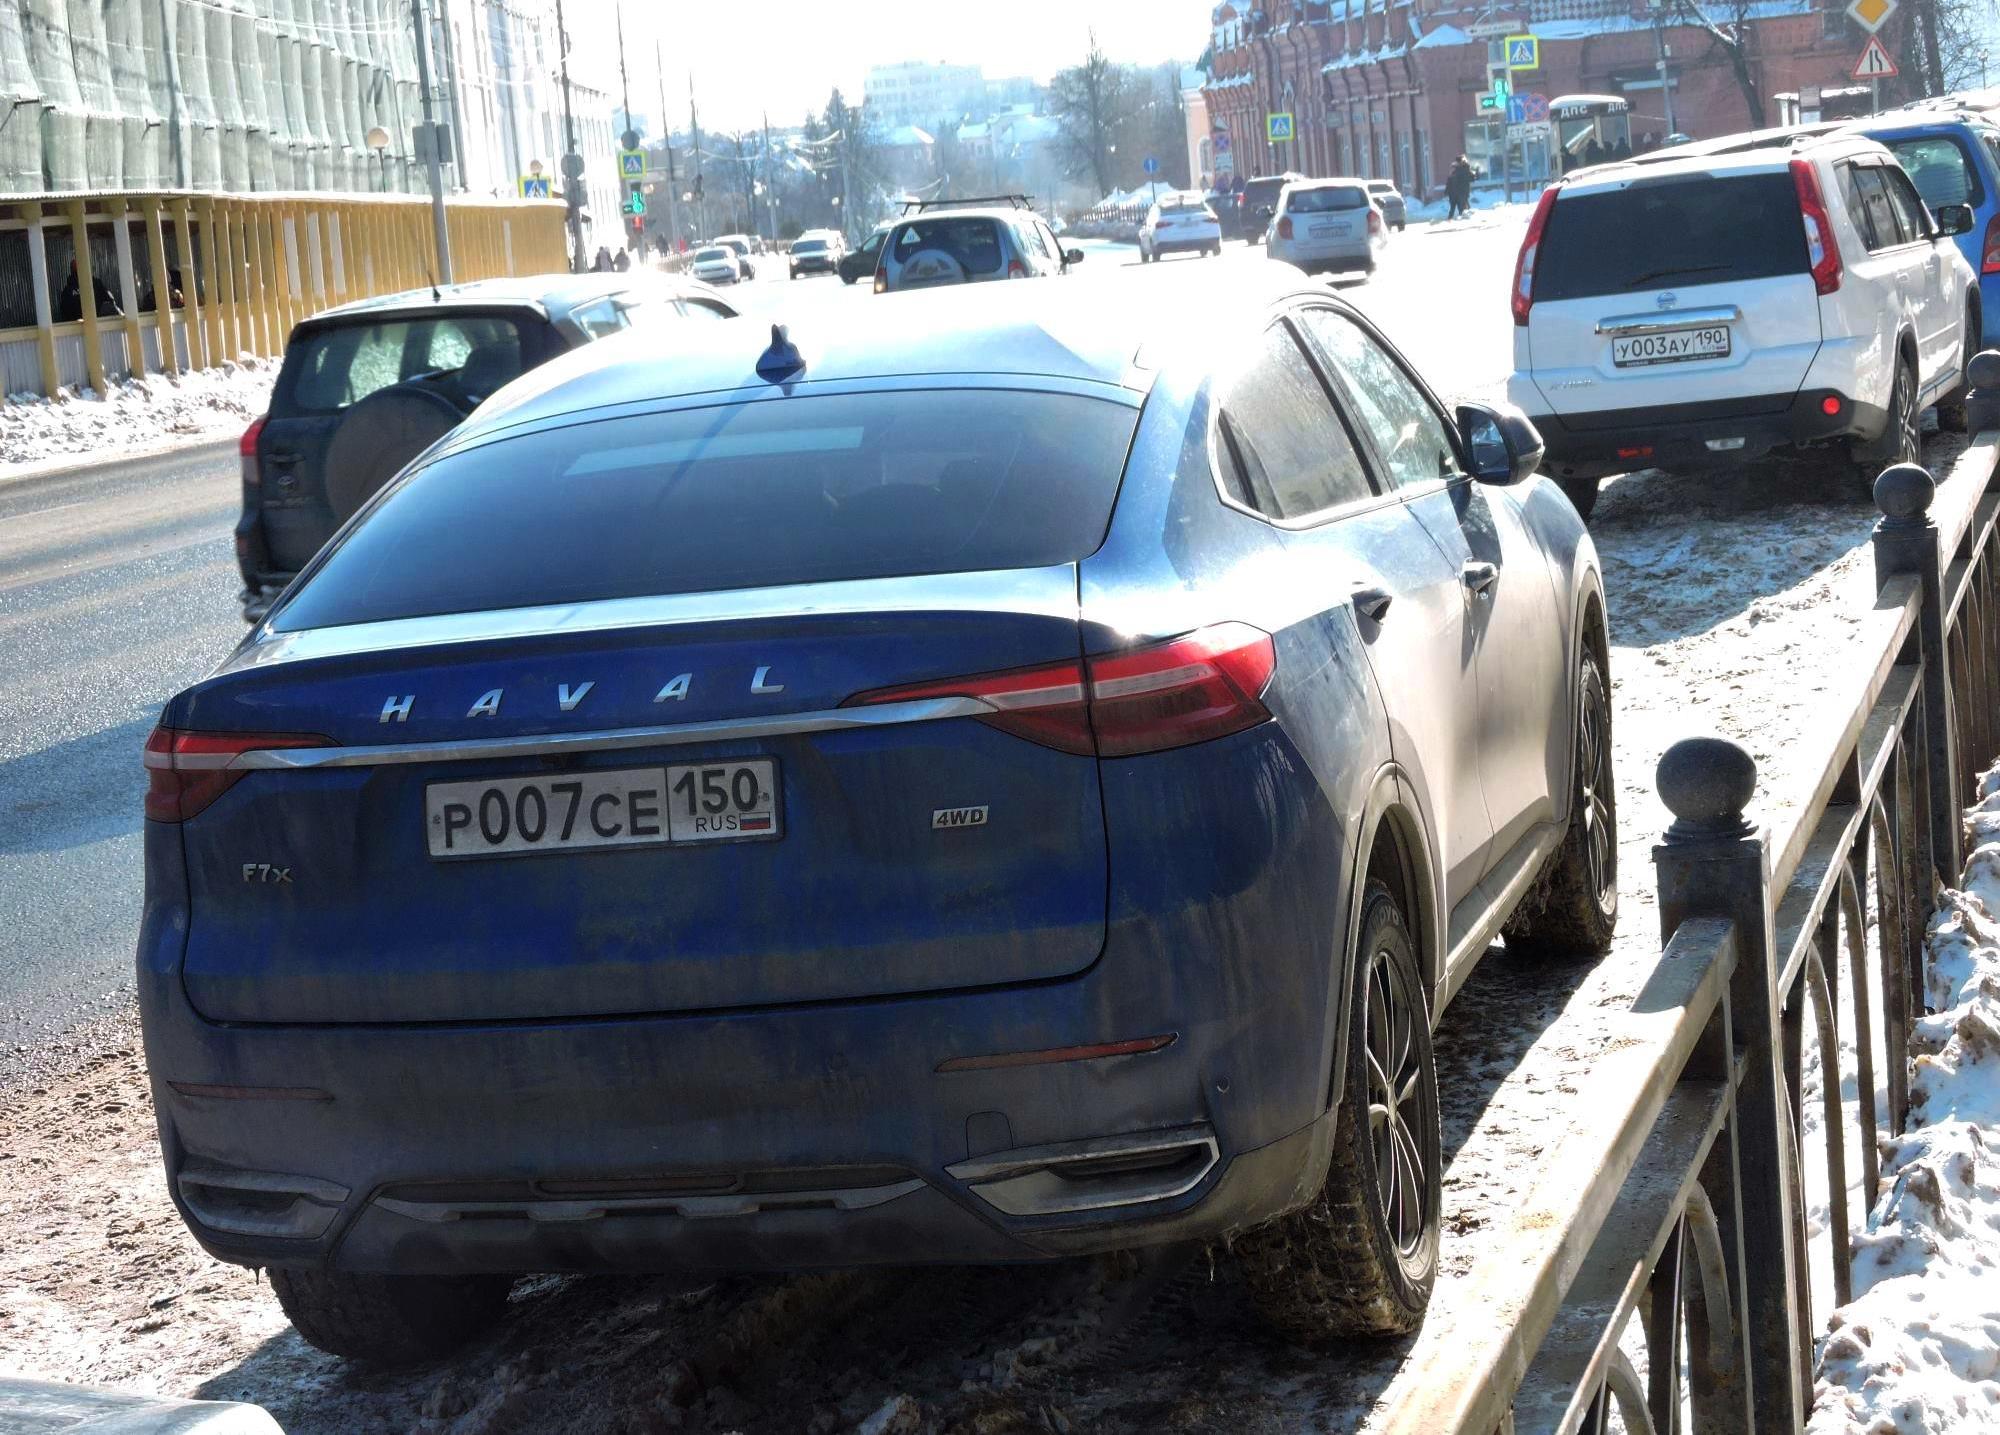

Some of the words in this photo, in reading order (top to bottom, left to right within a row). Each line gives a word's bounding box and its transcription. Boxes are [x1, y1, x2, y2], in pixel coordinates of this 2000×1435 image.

[1560, 105, 1588, 119] ДПС
[1607, 101, 1629, 114] ДПС
[1695, 330, 1722, 346] 190
[379, 666, 785, 723] HAVAL
[673, 768, 759, 816] 150
[695, 815, 738, 833] RUS
[936, 808, 984, 826] 4WD
